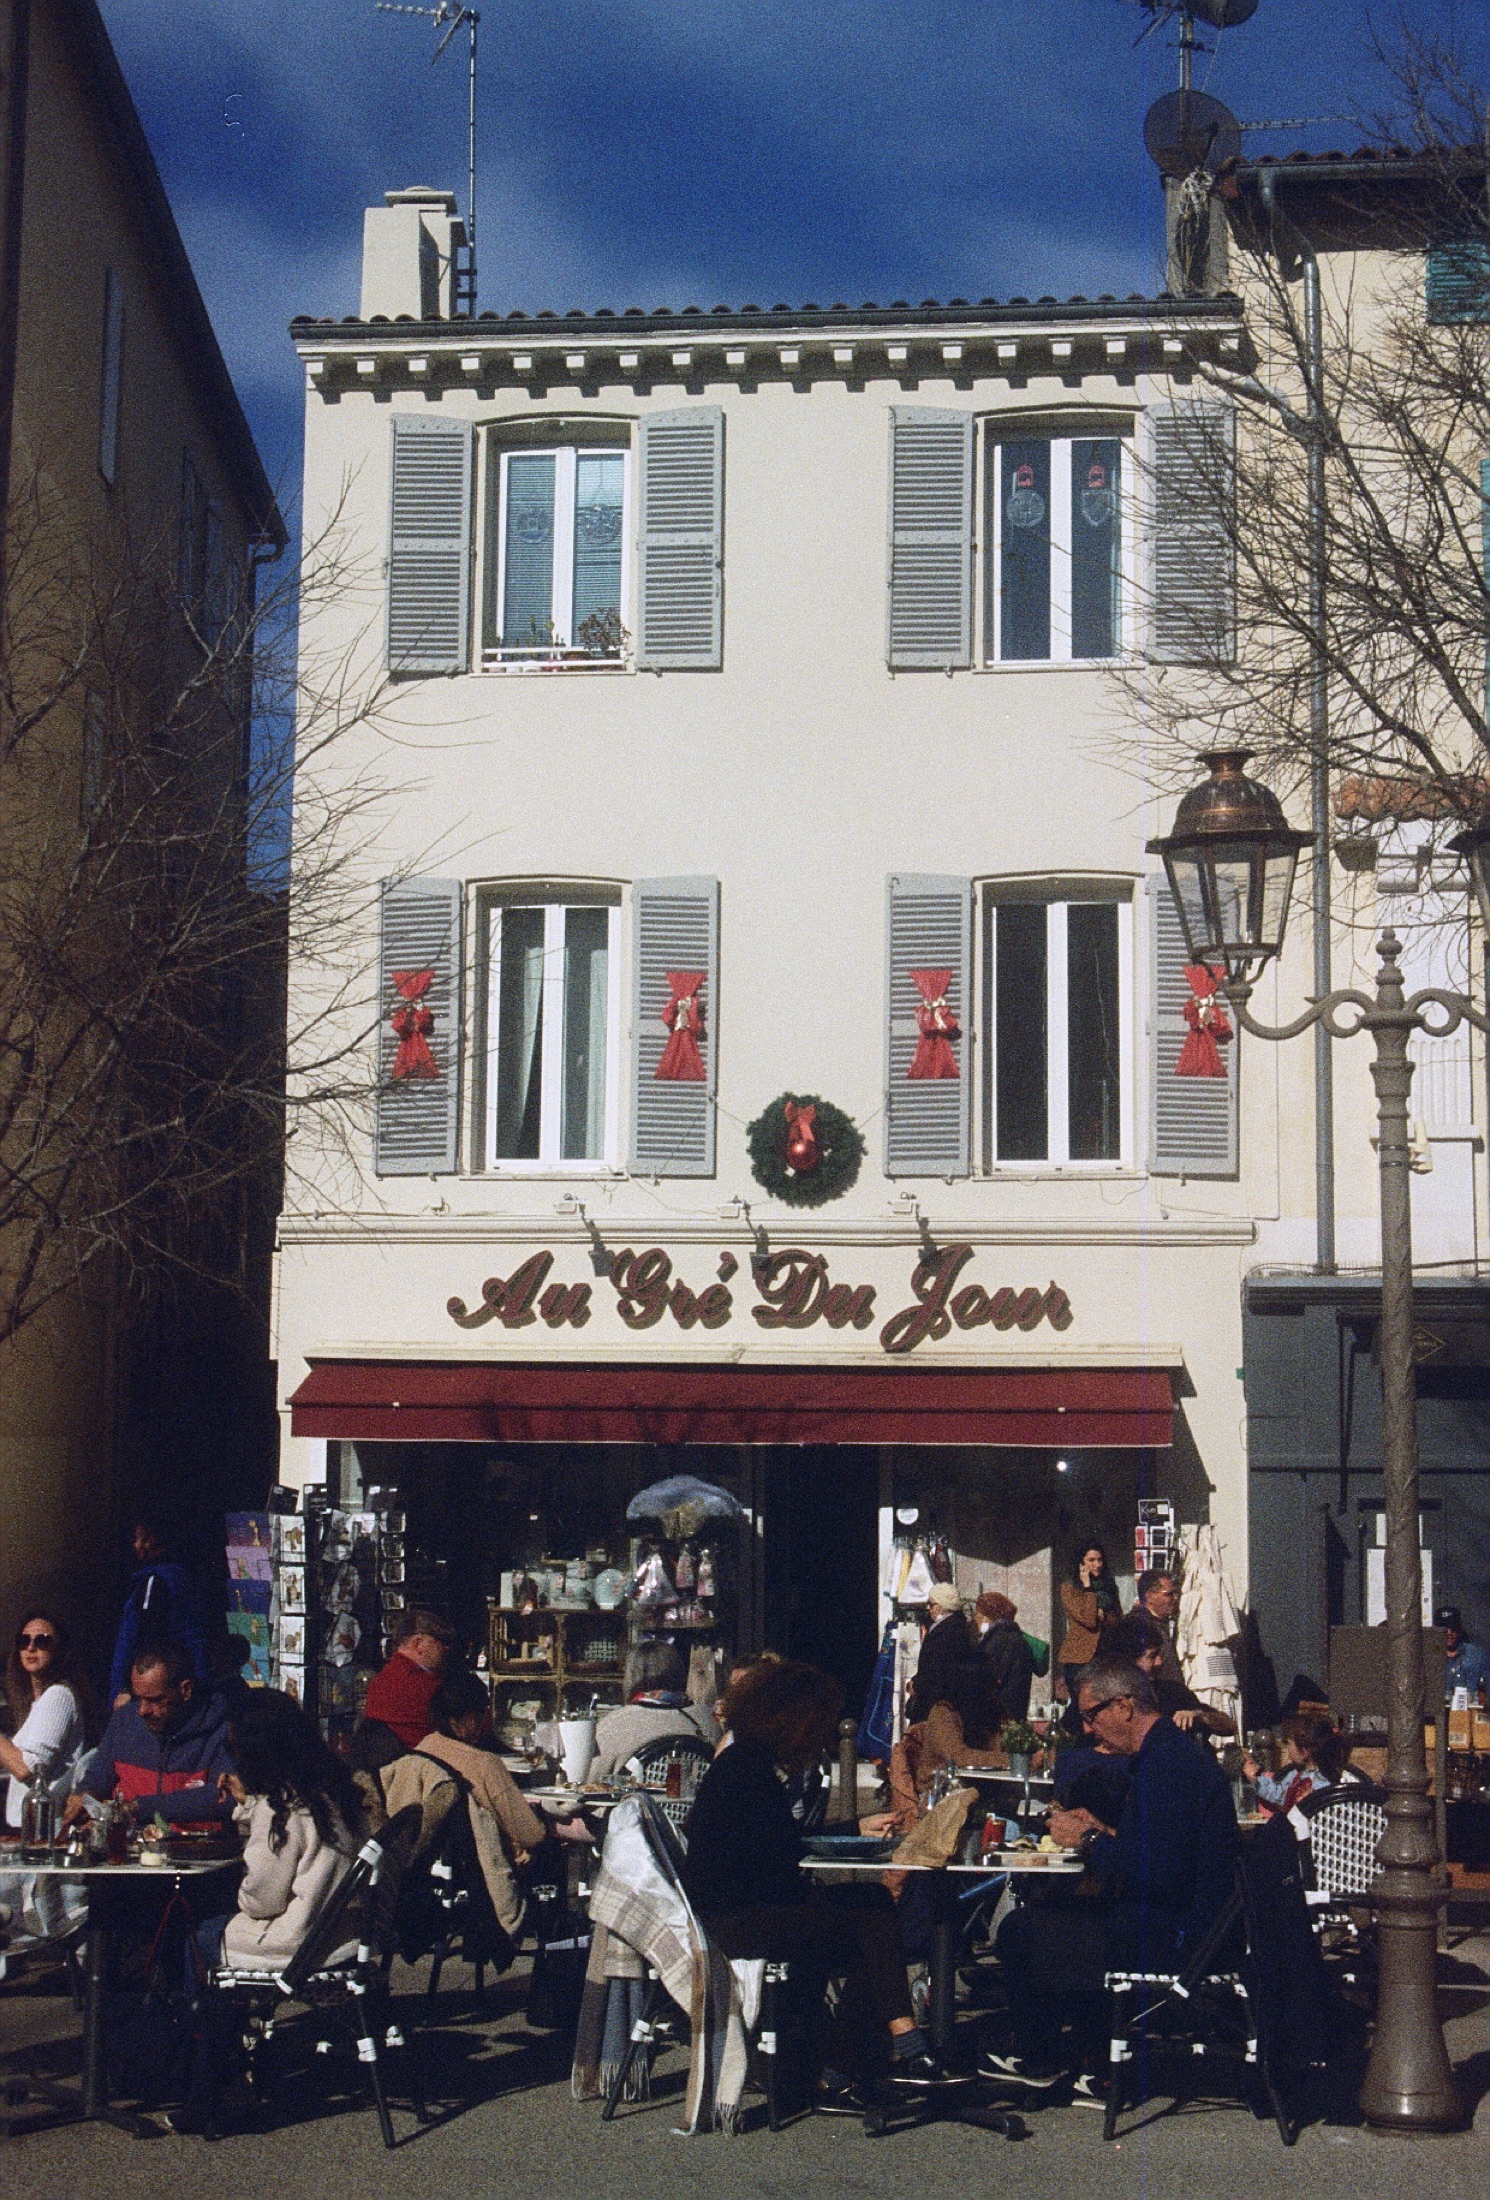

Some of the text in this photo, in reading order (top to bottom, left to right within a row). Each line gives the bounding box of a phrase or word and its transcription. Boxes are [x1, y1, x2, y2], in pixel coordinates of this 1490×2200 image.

[447, 1242, 1075, 1353] Au Gré Du Jour
